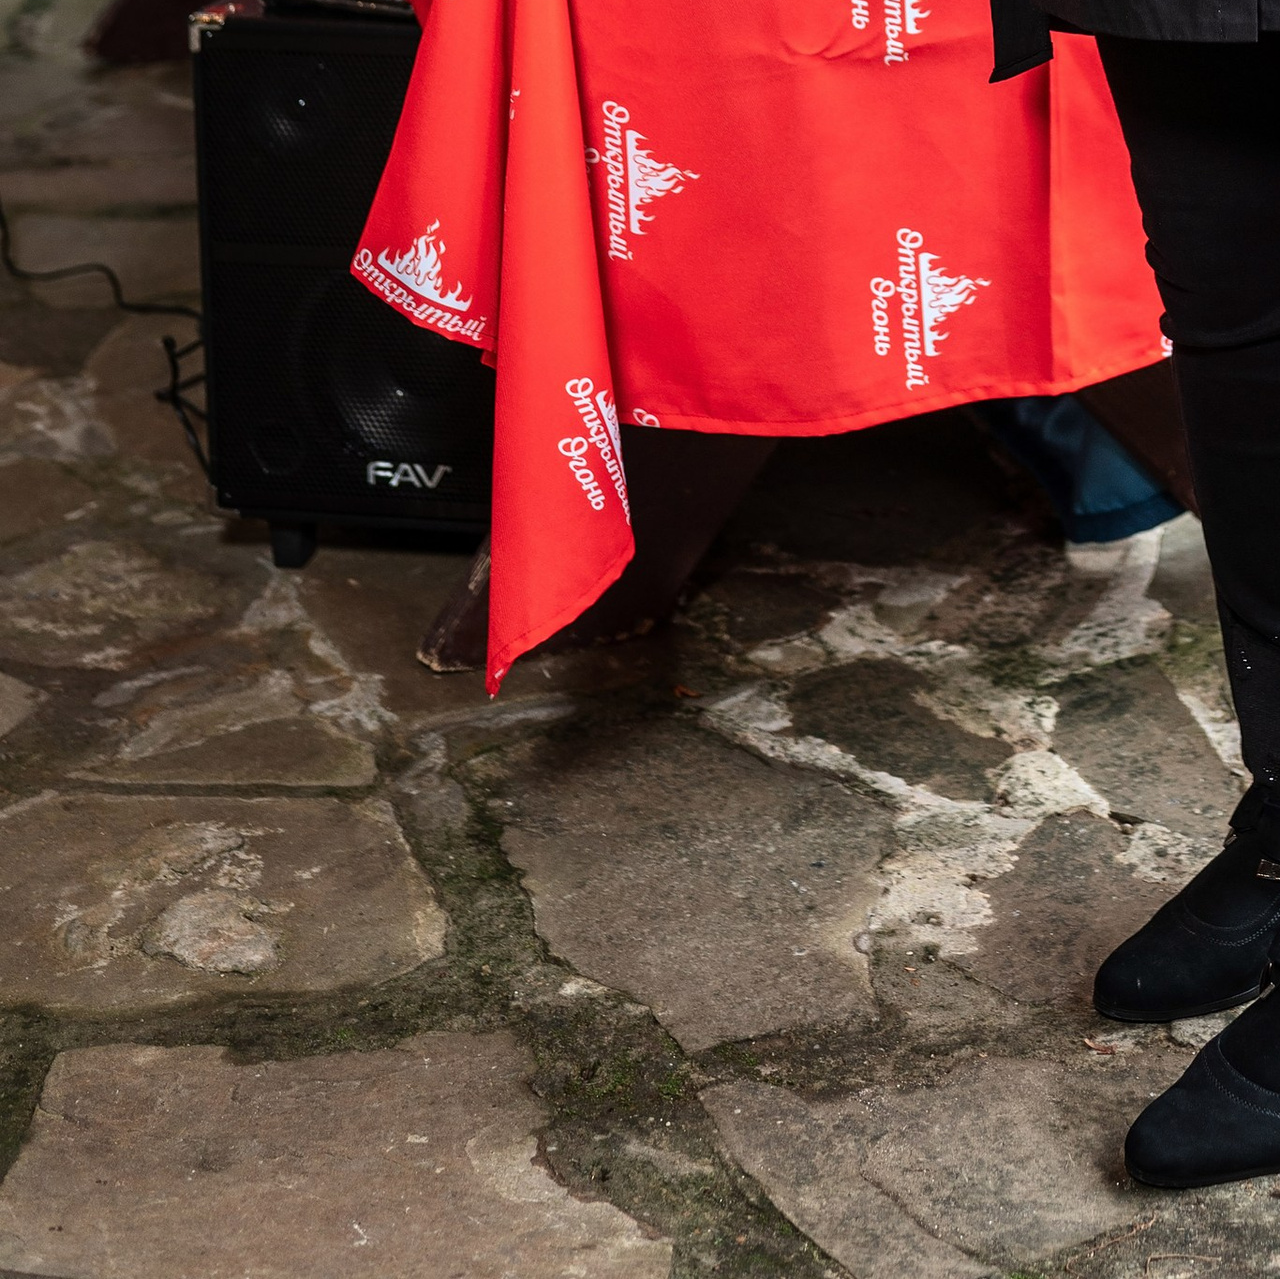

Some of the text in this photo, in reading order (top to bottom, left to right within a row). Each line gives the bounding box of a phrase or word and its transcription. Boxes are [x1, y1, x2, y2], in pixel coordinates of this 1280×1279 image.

[601, 99, 634, 262] Открытый
[353, 247, 488, 342] Открытый
[869, 276, 896, 357] Огонь
[896, 227, 930, 392] Открытый
[366, 460, 452, 489] FAV
[557, 435, 605, 512] Огонь
